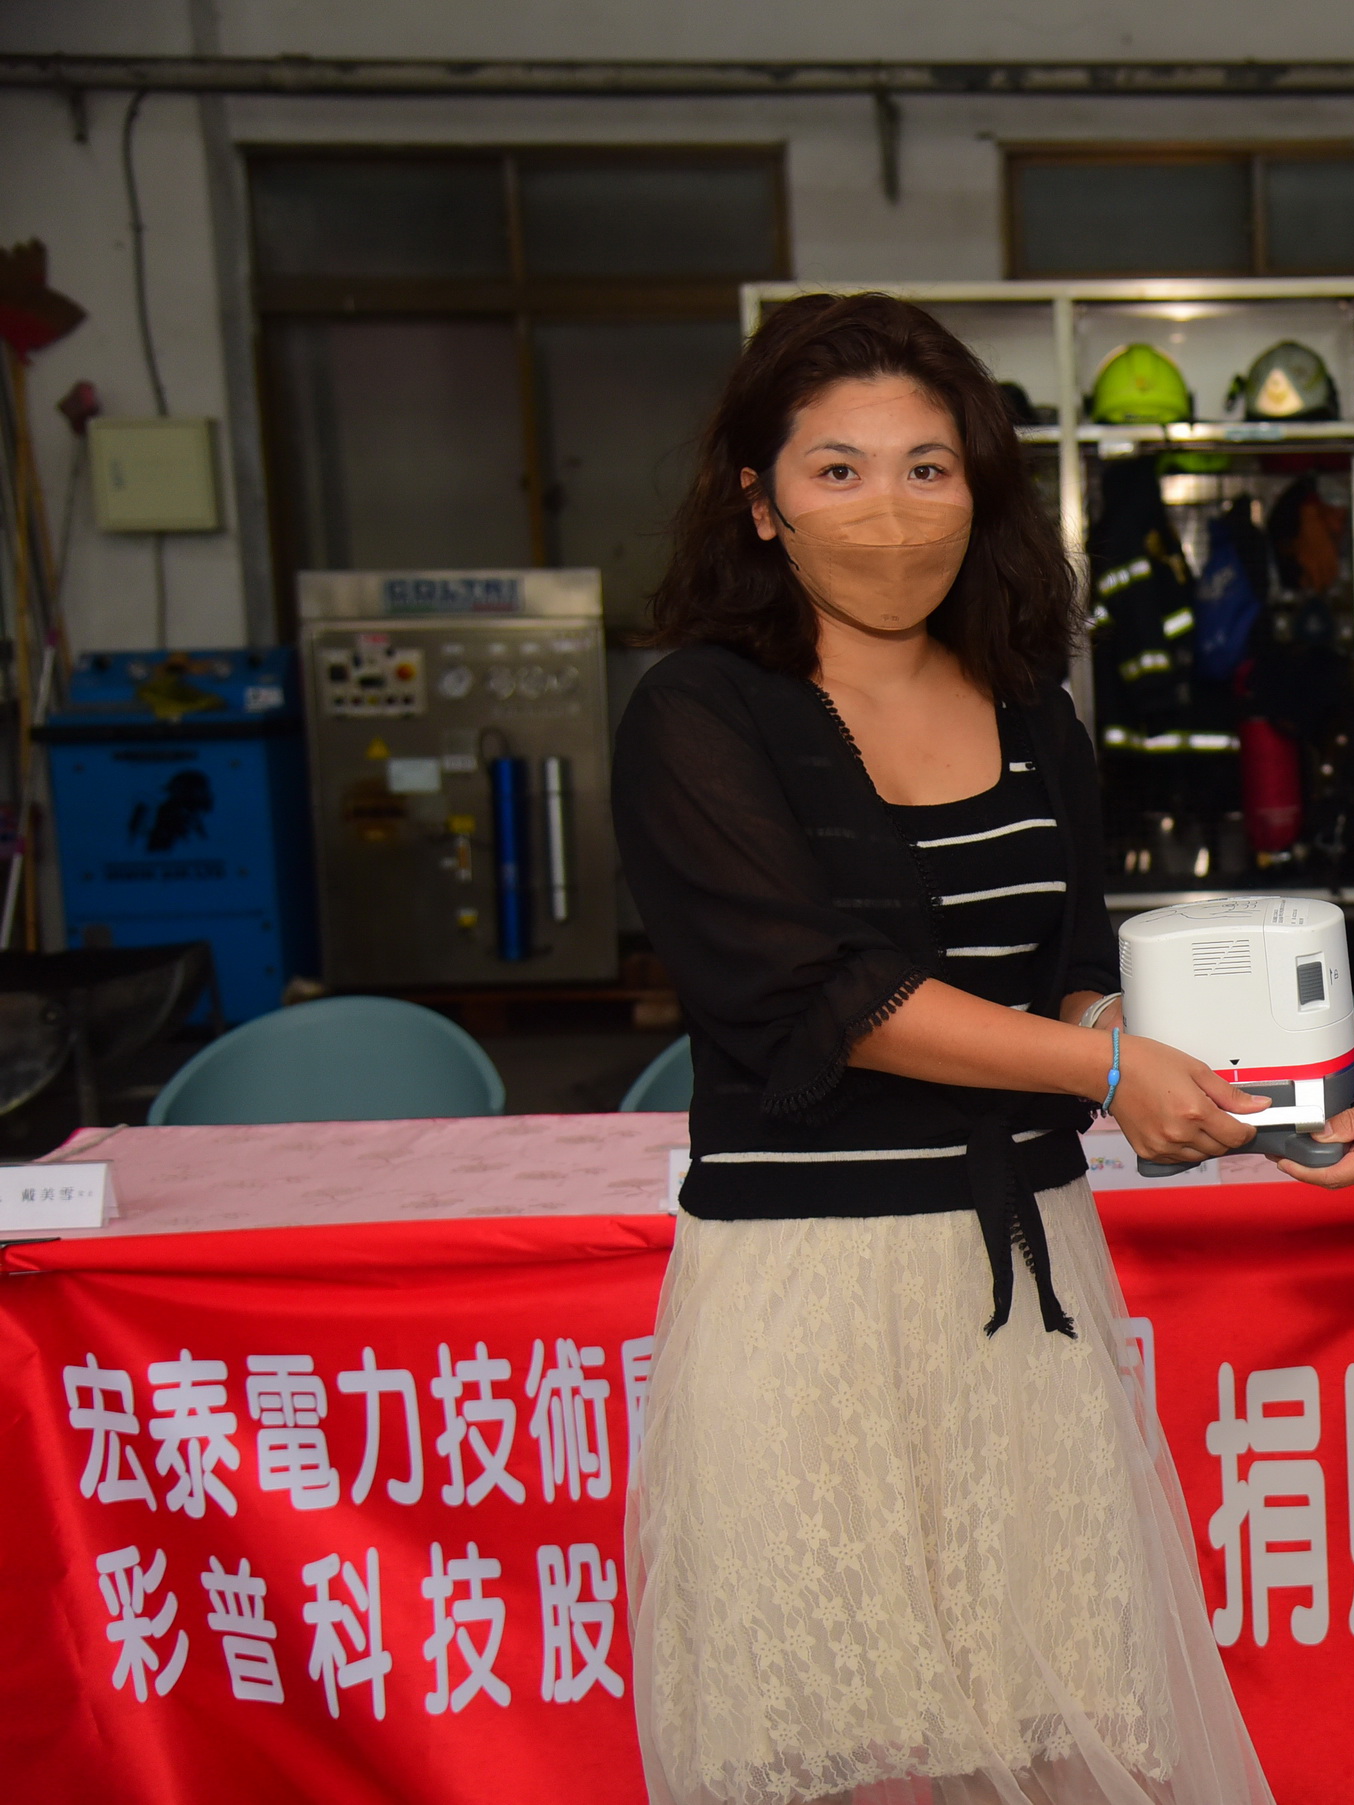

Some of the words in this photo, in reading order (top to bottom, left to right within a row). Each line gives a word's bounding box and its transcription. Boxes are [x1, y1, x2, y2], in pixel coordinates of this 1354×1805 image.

[96, 1542, 625, 1721] 彩普科技股
